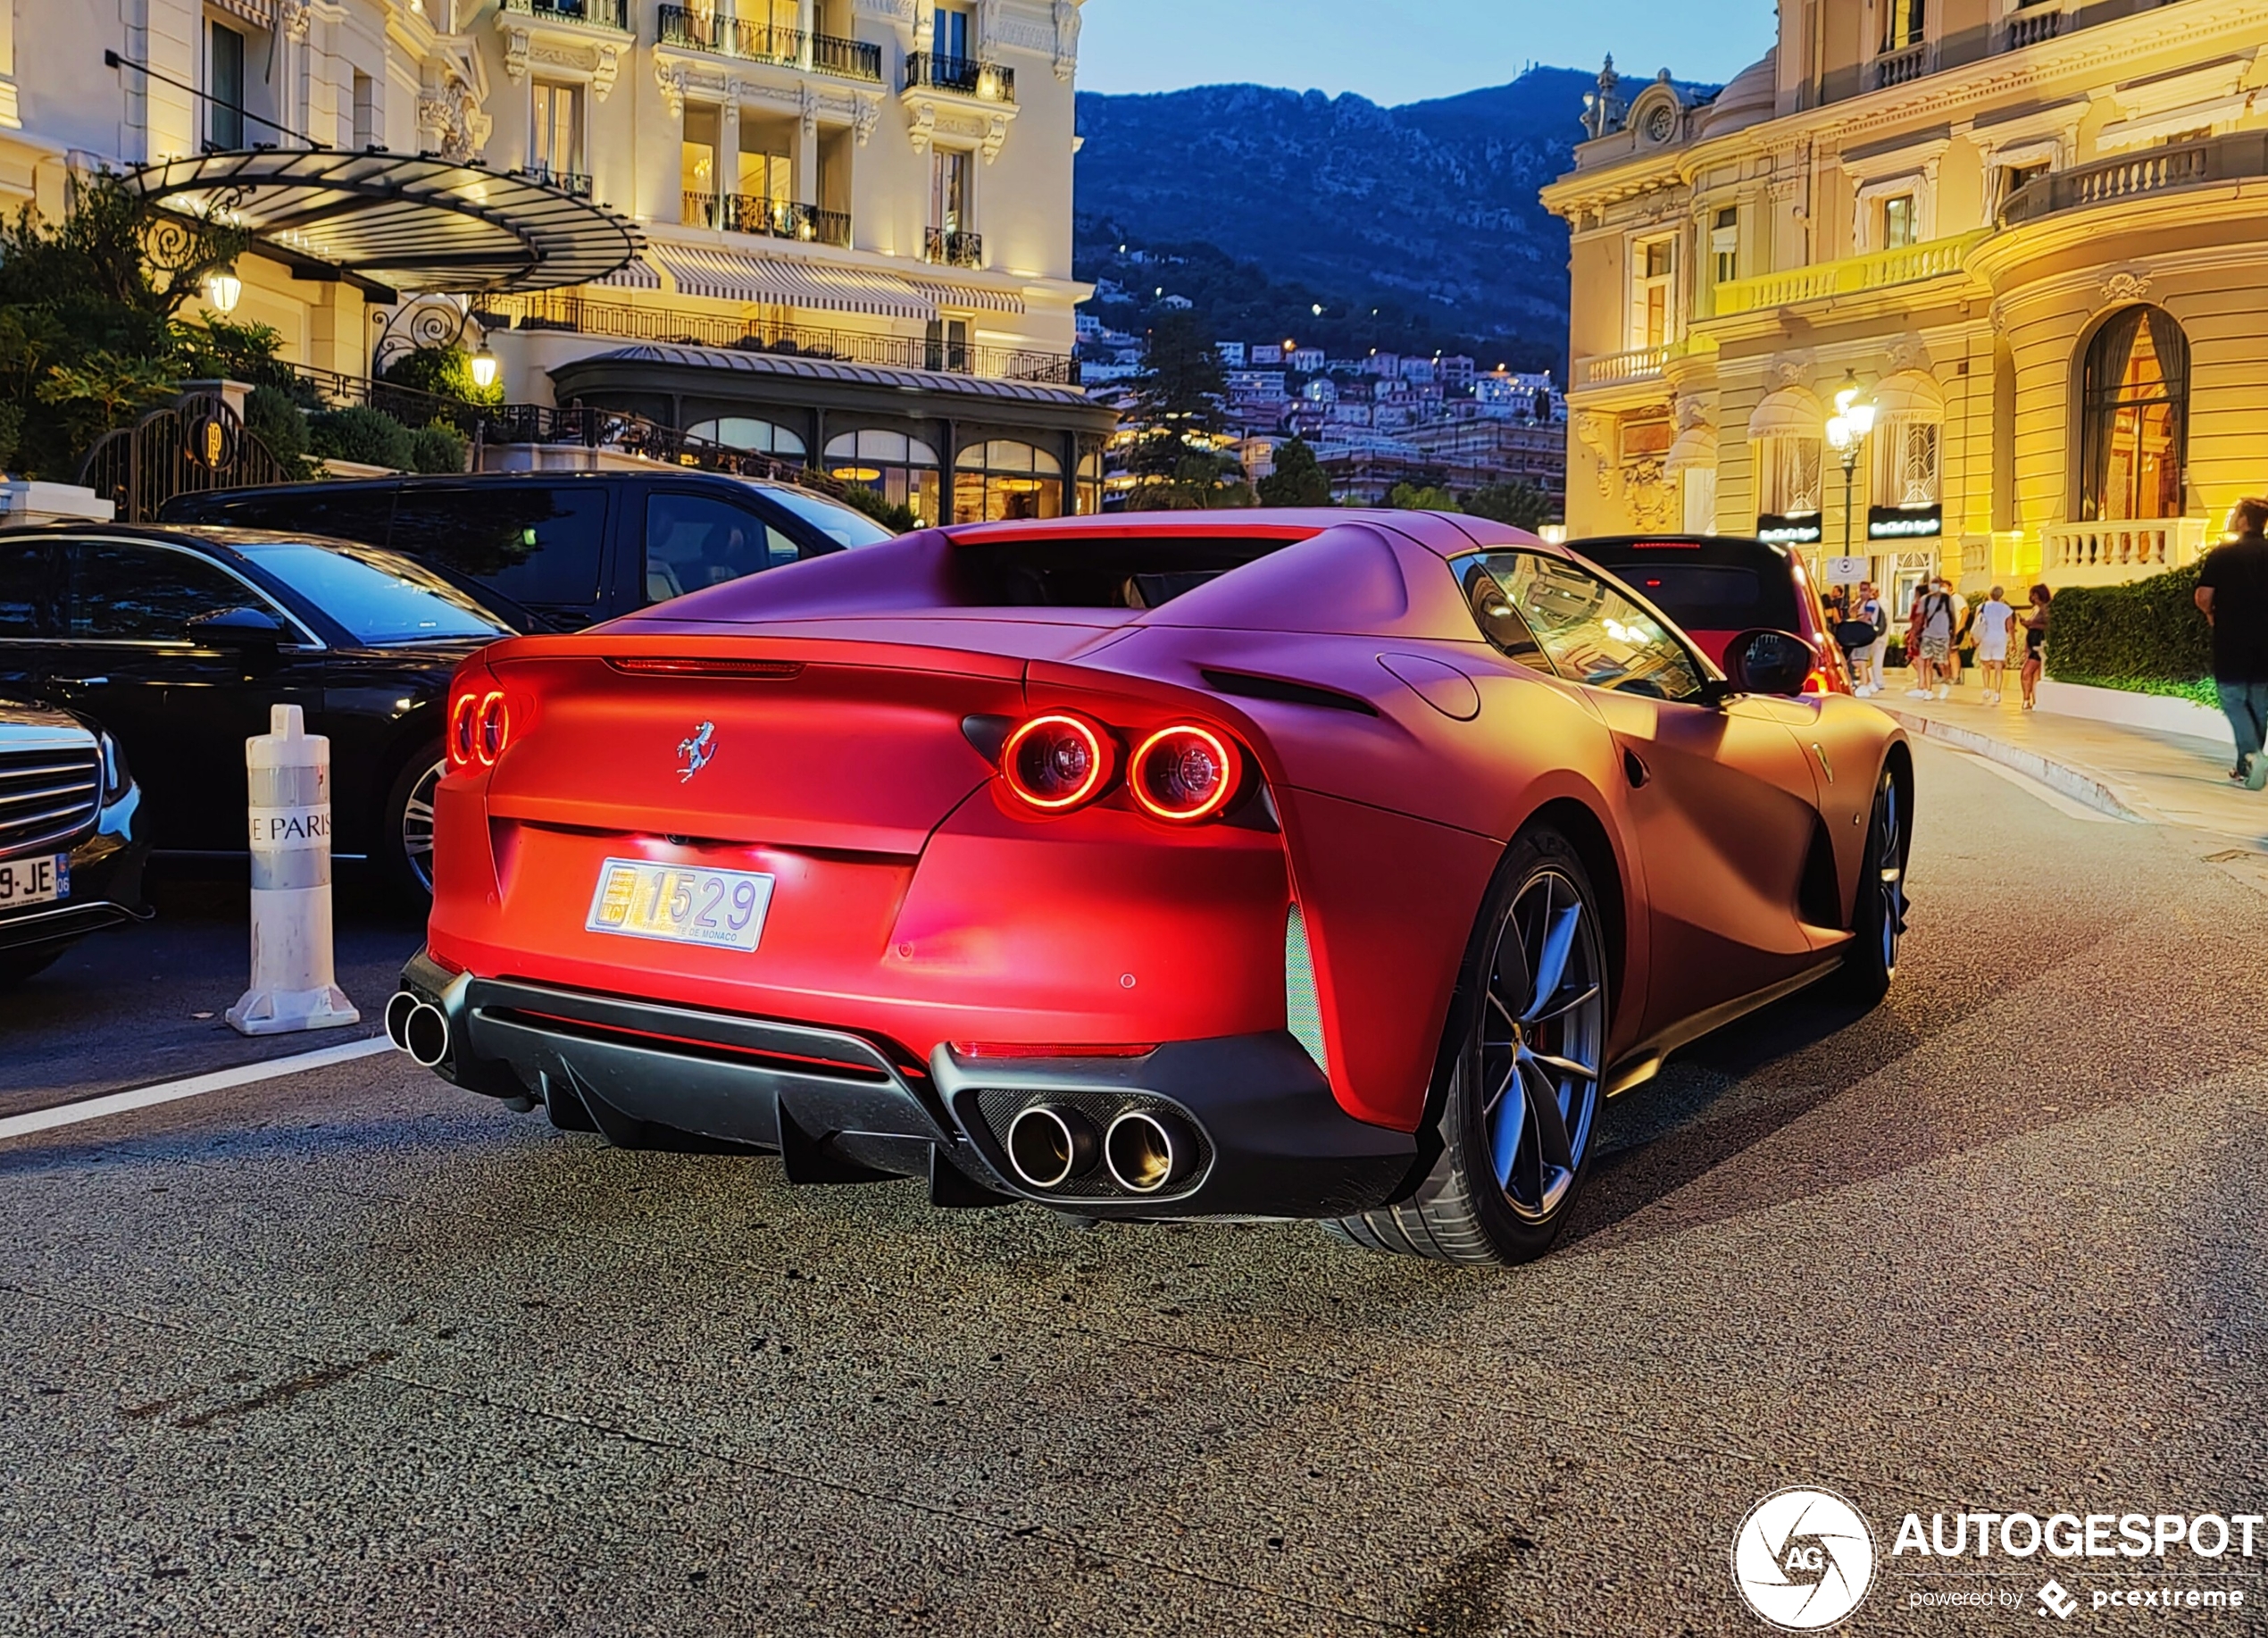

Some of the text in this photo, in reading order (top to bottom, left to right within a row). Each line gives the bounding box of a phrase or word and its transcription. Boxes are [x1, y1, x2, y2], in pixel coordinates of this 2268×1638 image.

[271, 813, 330, 840] PARIS
[56, 877, 71, 893] 06
[646, 871, 757, 931] 1529
[702, 930, 738, 942] MONACO
